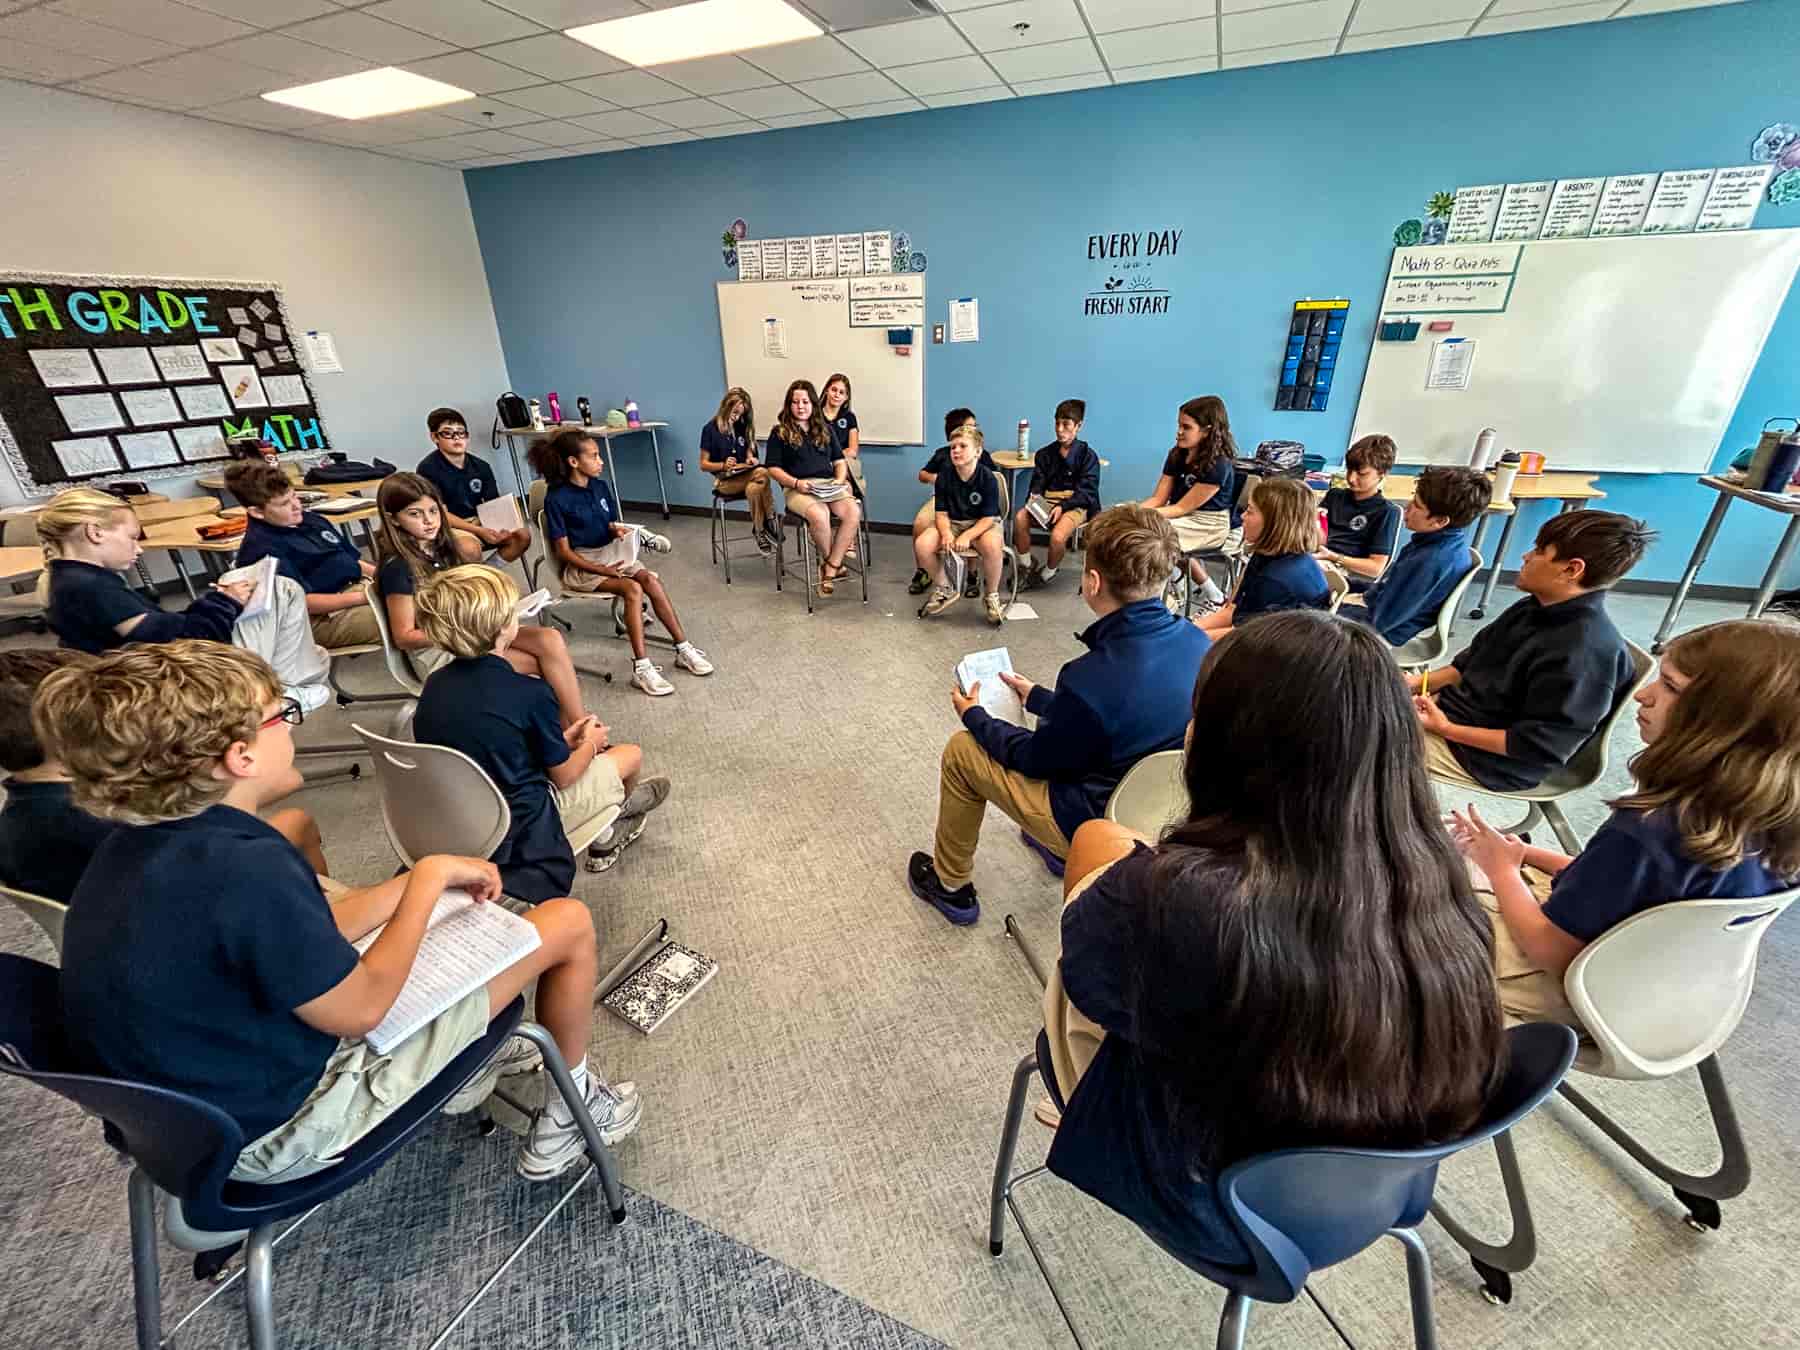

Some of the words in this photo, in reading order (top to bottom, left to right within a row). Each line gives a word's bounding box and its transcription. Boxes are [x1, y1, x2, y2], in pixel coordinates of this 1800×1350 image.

[1562, 182, 1594, 192] ABSENT?
[1087, 231, 1143, 260] EVERY
[1146, 228, 1184, 256] DAY
[1400, 255, 1431, 272] Math
[66, 289, 221, 335] GRADE
[1084, 296, 1125, 315] FRESH
[1127, 295, 1173, 314] START
[222, 414, 325, 452] MATH
